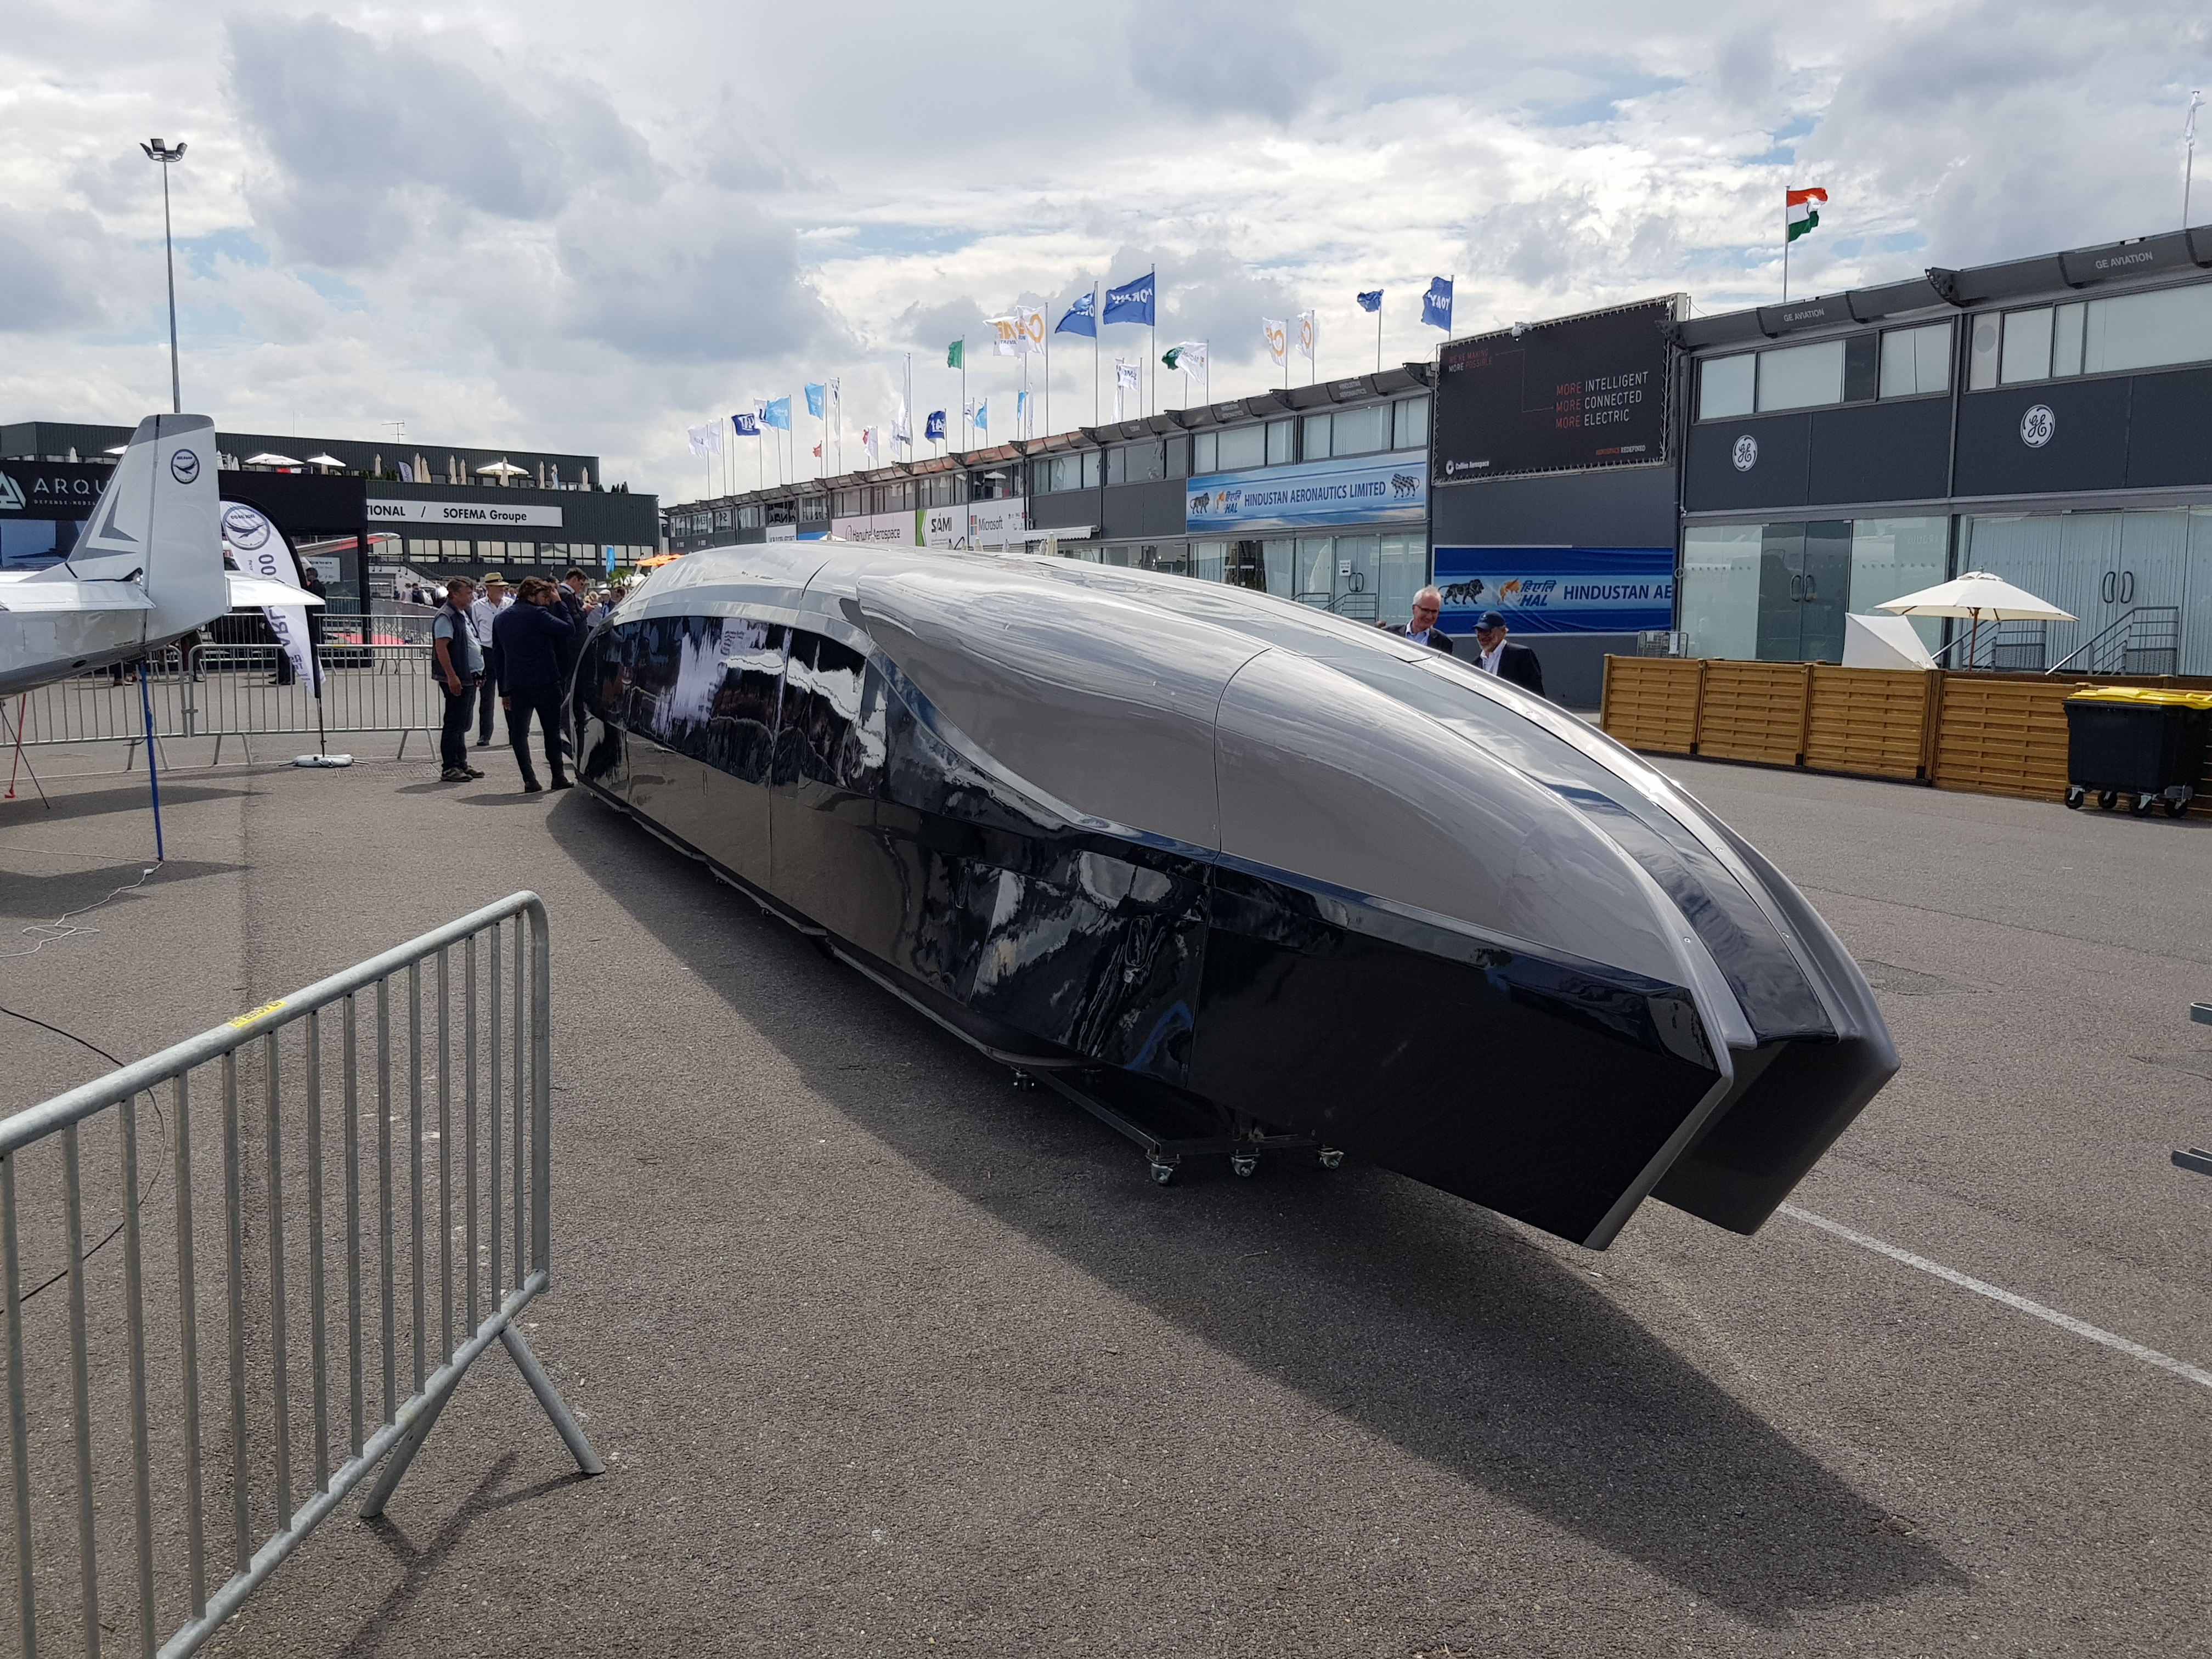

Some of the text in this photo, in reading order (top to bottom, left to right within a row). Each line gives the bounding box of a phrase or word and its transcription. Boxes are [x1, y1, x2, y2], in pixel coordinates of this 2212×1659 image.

[2096, 251, 2153, 269] GE AVIATION
[1784, 308, 1825, 322] GE AVIATION
[1448, 357, 1492, 373] MORE POSSIBLE
[1556, 371, 1649, 396] MORE INTELLIGENT
[1556, 390, 1642, 413] MORE CONNECTED
[1556, 409, 1629, 429] MORE ELECTRIC
[1621, 445, 1646, 453] REDEFINED
[1469, 461, 1489, 469] Aerospace
[1244, 481, 1386, 507] HINDUSTAN AERONAUTICS LIMITED
[443, 508, 487, 520] SOFEMA
[490, 510, 527, 523] Groupe
[1224, 503, 1238, 514] HAL
[978, 516, 1003, 532] Microsoft
[873, 528, 901, 541] Aerospace
[1564, 585, 1649, 600] HINDUSTAN
[1519, 594, 1548, 607] HAL
